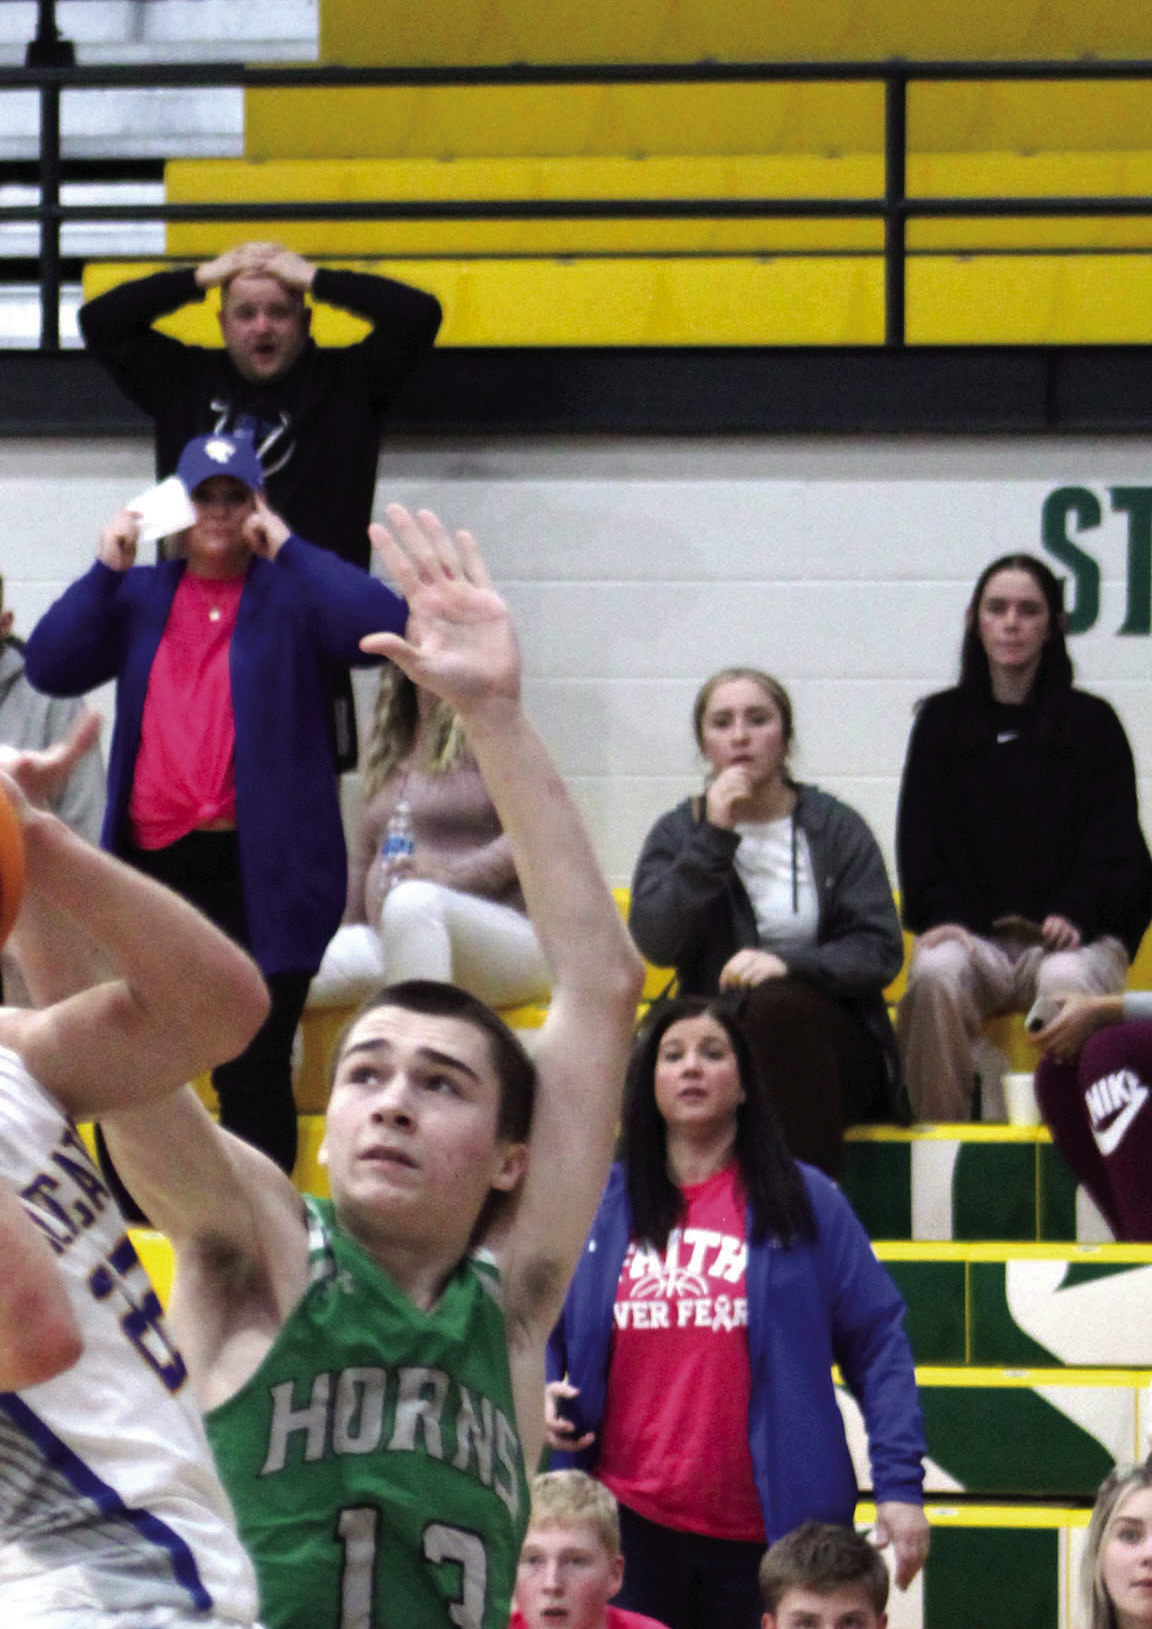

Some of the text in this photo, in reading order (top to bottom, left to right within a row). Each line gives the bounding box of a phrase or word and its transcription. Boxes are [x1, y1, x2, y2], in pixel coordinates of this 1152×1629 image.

[1084, 1067, 1140, 1127] NIKE
[618, 1226, 748, 1284] AITH
[613, 1300, 670, 1331] VER
[255, 1366, 521, 1524] HORNS
